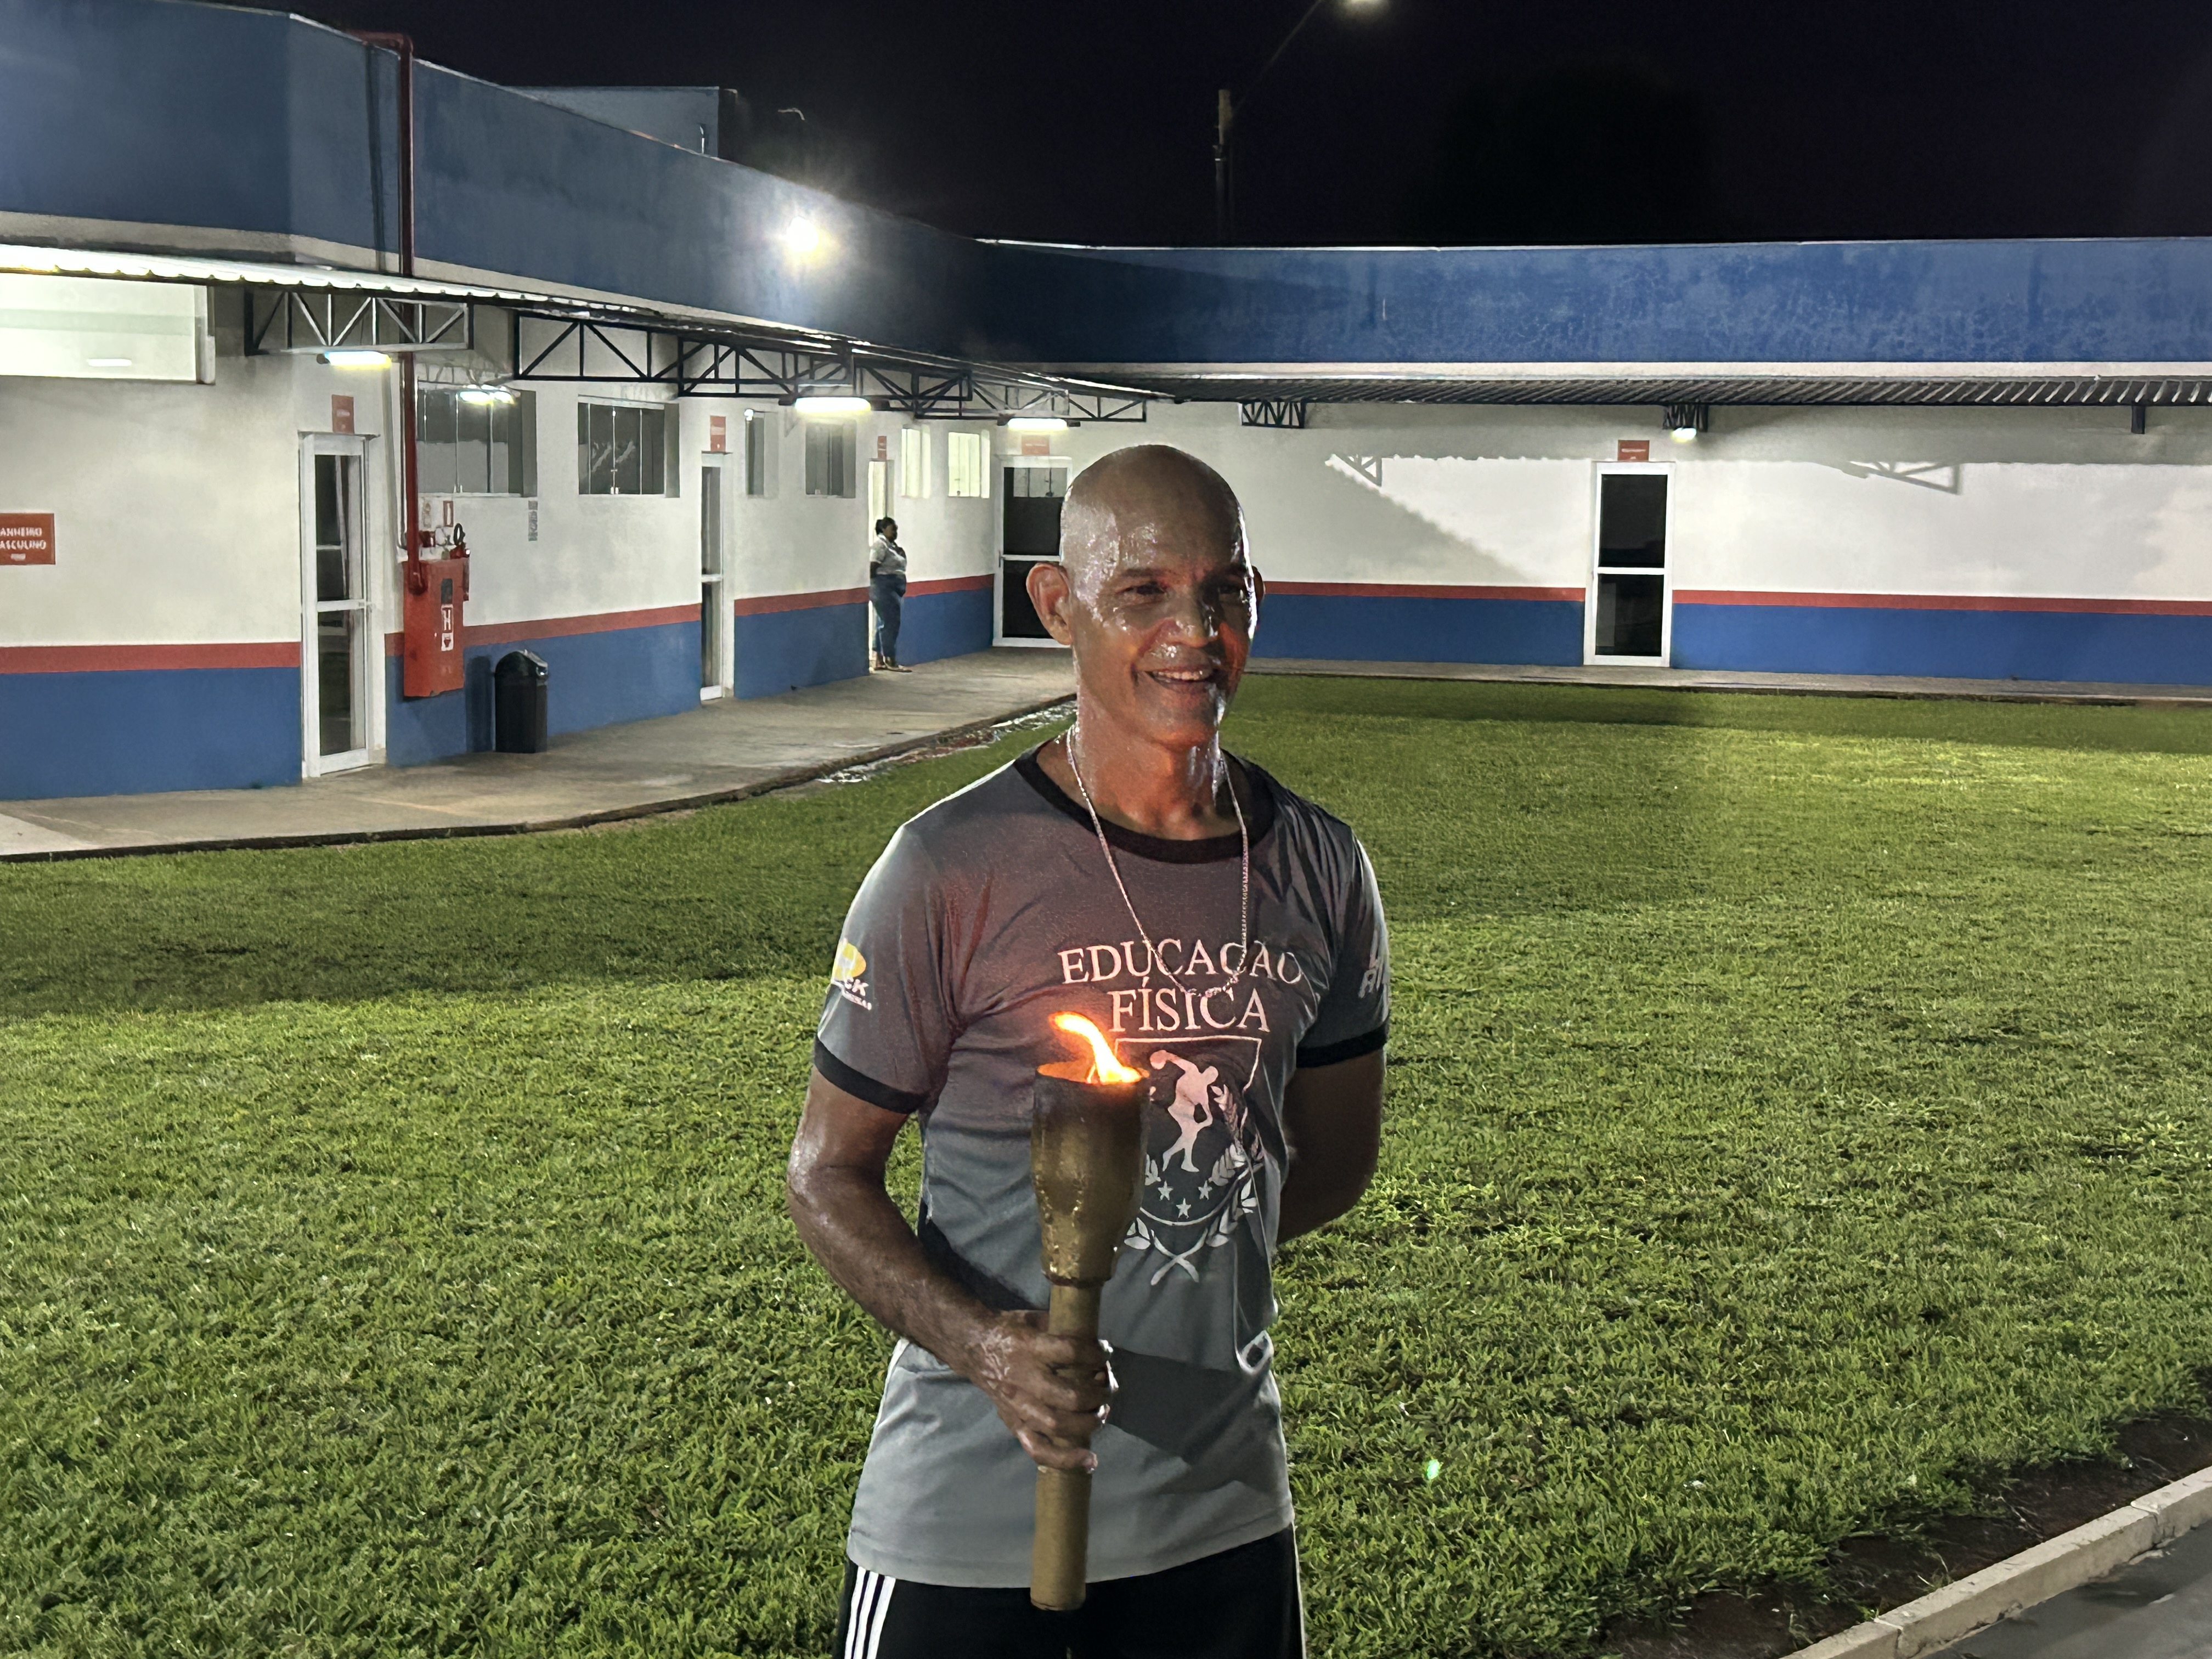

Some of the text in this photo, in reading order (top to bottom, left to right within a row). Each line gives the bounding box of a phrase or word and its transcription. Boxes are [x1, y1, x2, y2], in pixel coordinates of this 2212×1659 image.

[0, 527, 42, 537] ANHEIRO
[0, 540, 46, 550] ASCULINO
[1107, 976, 1270, 1032] FÍSICA
